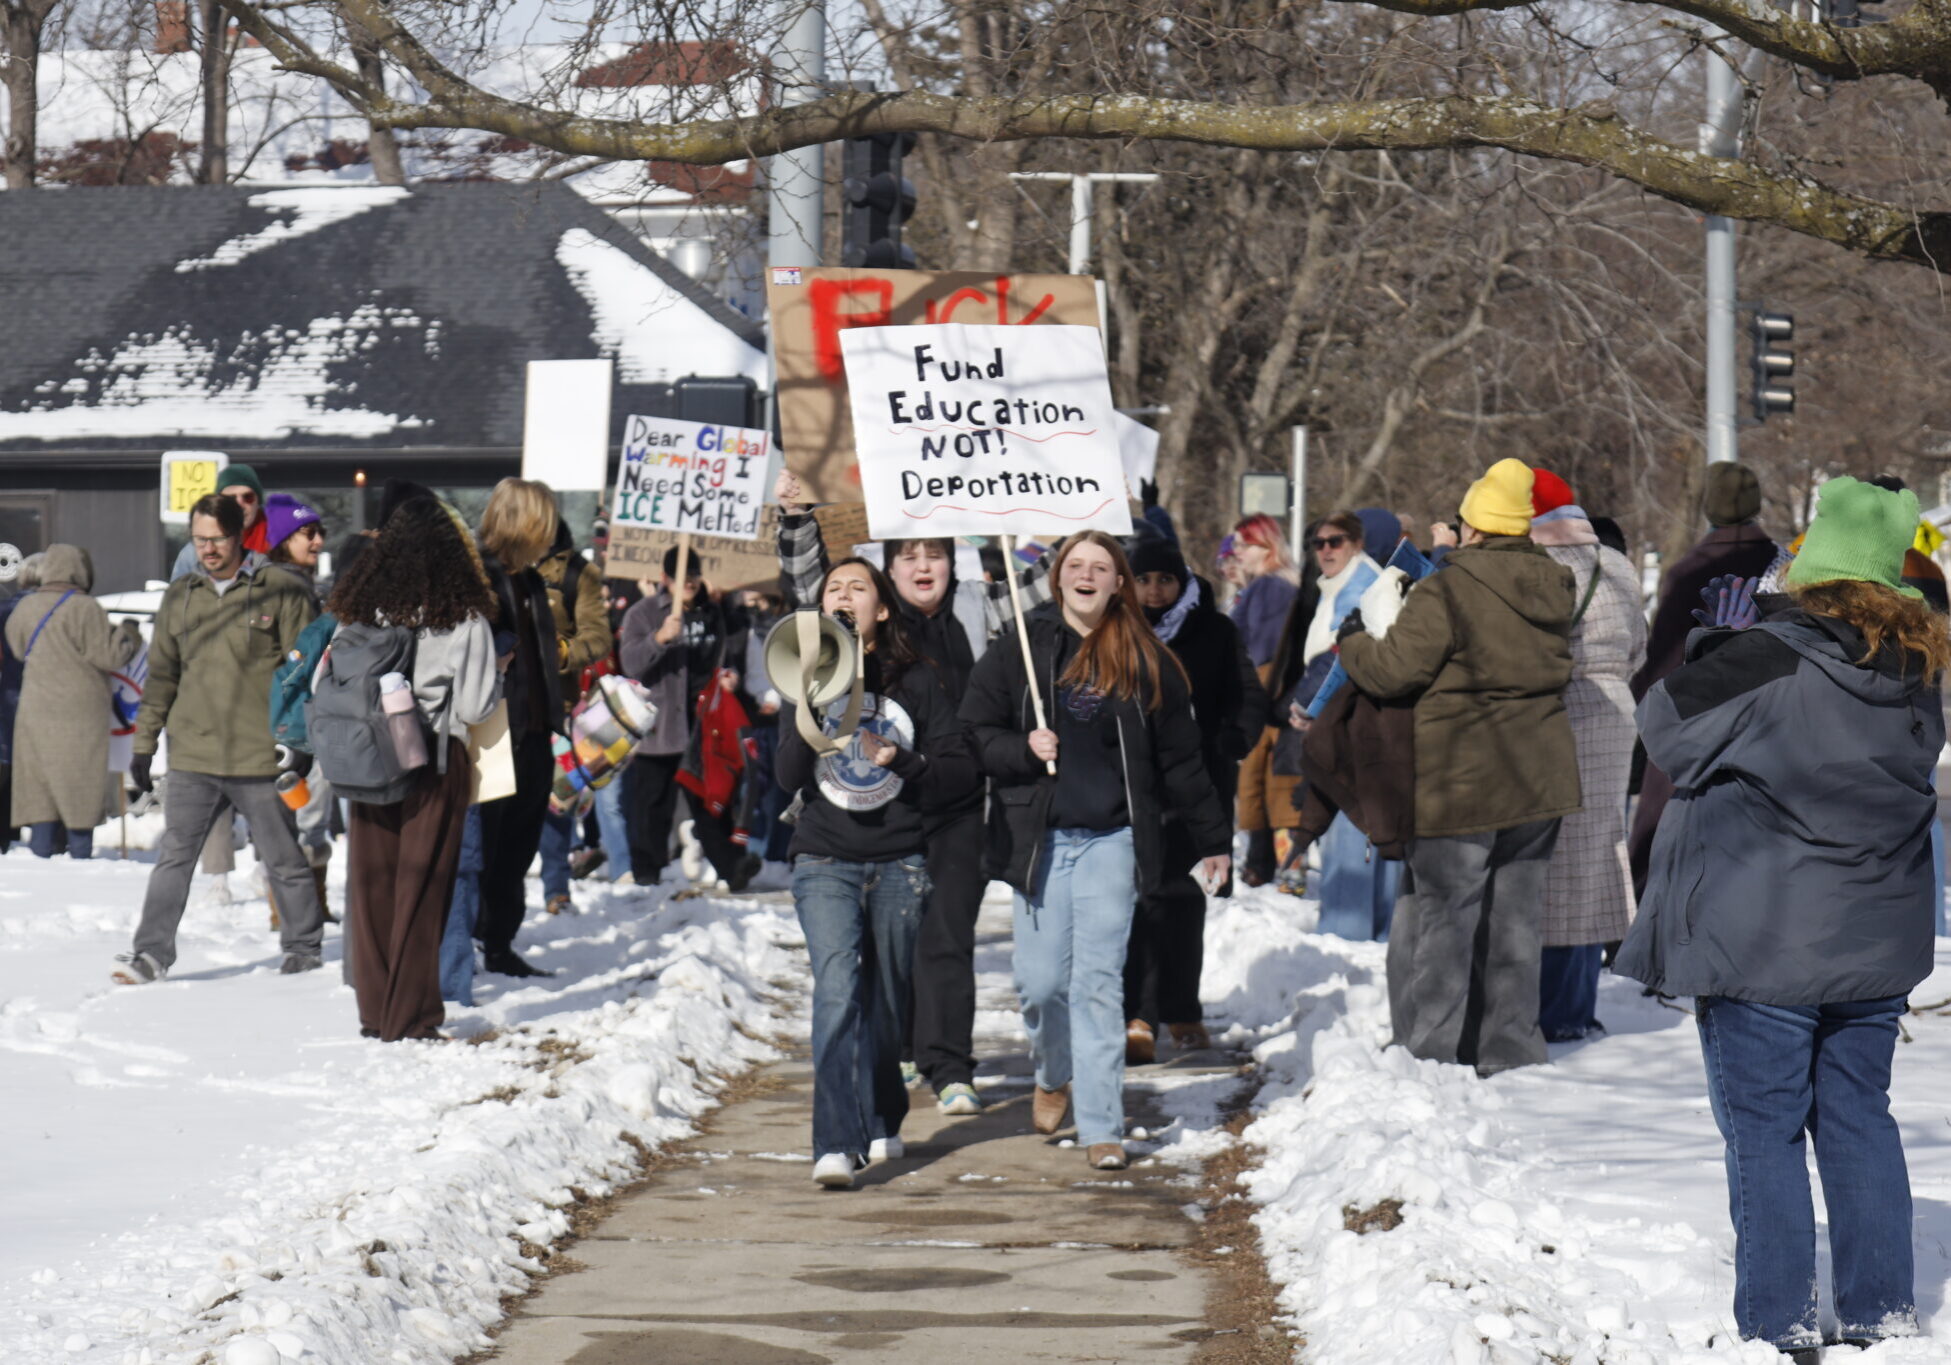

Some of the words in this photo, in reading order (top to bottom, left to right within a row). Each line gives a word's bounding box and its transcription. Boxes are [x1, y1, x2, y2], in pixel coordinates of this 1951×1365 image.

[914, 344, 1004, 382] Fund
[888, 391, 1084, 425] Education
[632, 416, 685, 446] Dear
[696, 425, 769, 456] Global
[921, 429, 1008, 461] NOT!
[182, 462, 204, 483] NO
[623, 465, 687, 496] Need
[691, 473, 749, 504] Some
[626, 446, 728, 487] Warming
[735, 456, 750, 479] I
[901, 470, 1100, 500] Deportation
[617, 492, 664, 524] ICE
[677, 500, 759, 534] Melted
